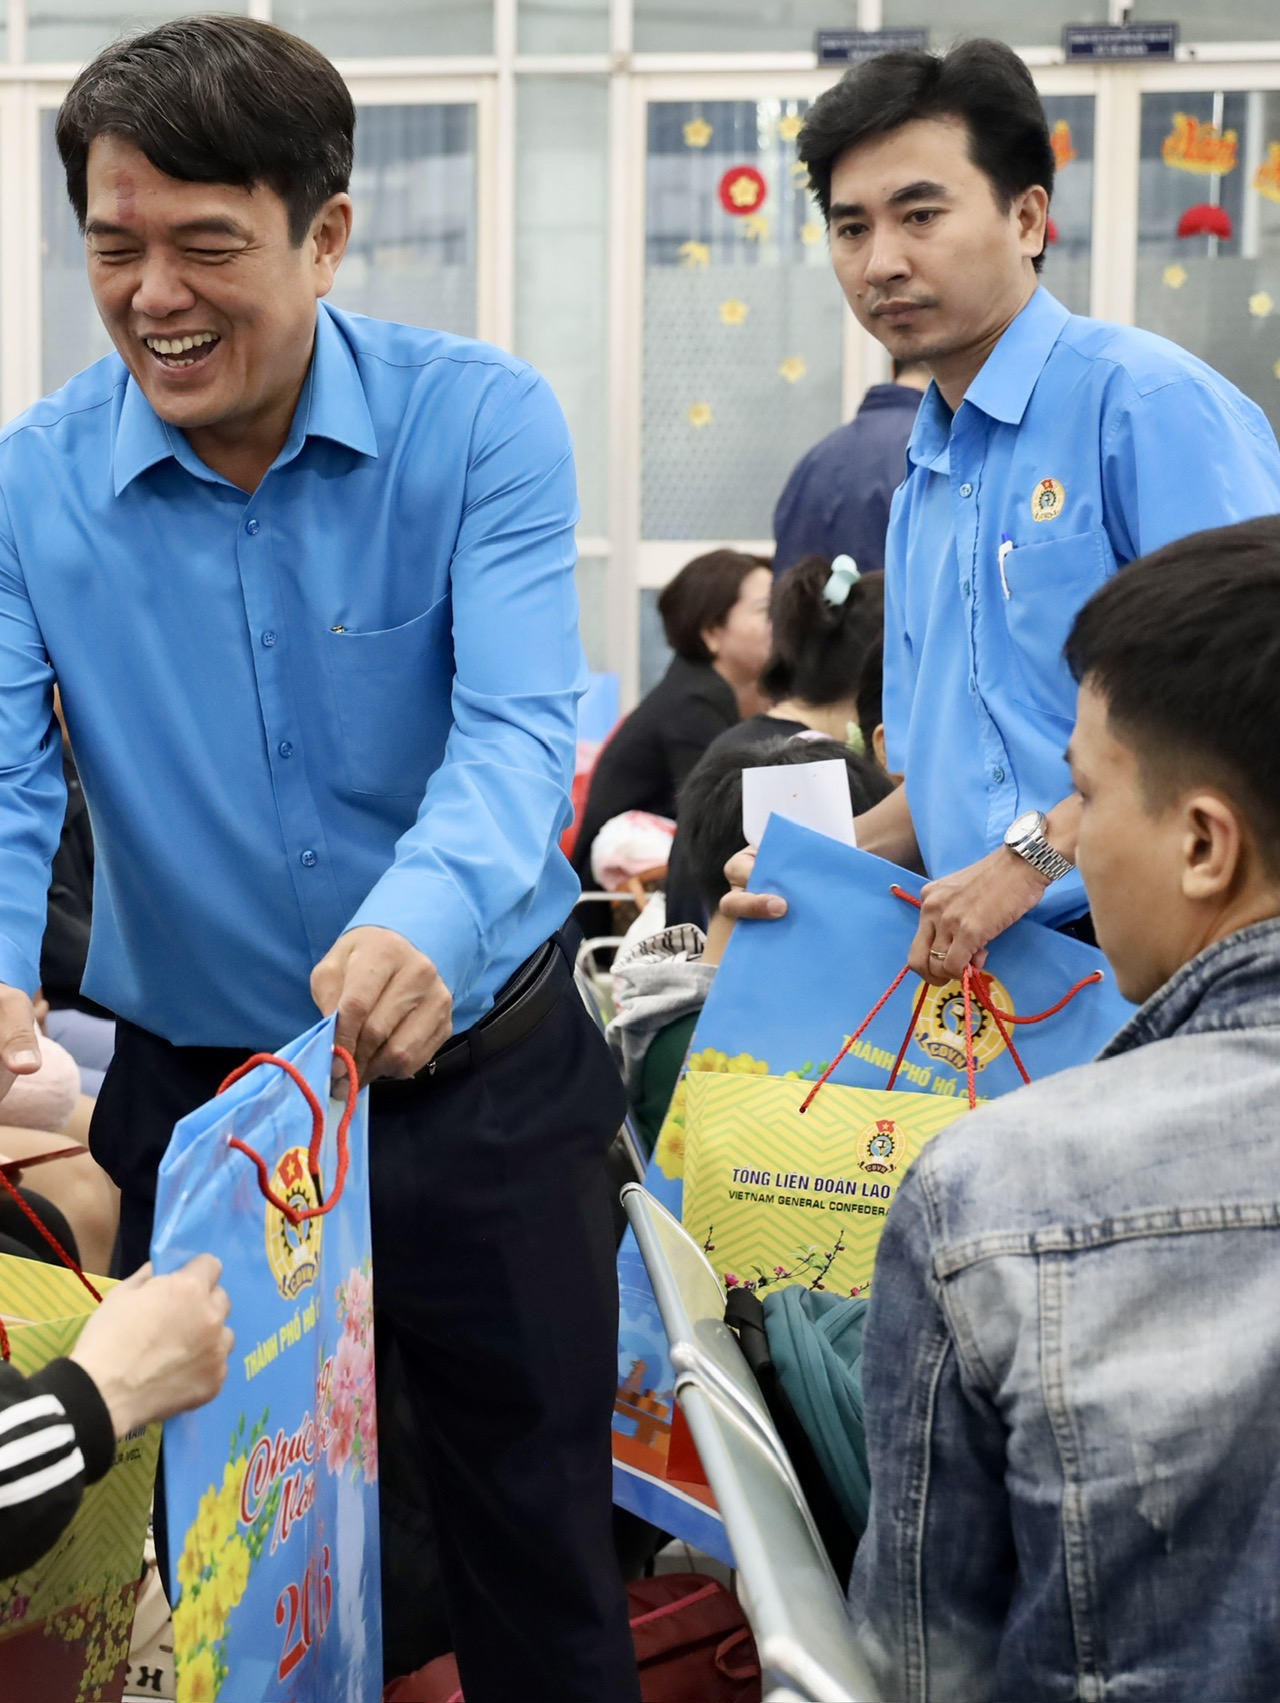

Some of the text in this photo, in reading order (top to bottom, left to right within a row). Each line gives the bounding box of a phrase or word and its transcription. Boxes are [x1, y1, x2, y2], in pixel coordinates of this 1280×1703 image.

[842, 1034, 897, 1071] THÀNH
[897, 1060, 933, 1087] PHỐ
[776, 1171, 810, 1191] LIÊN
[814, 1177, 857, 1196] ĐOÀN
[862, 1183, 891, 1199] LAO
[729, 1190, 774, 1204] VIETNAM
[778, 1196, 825, 1209] GENERAL
